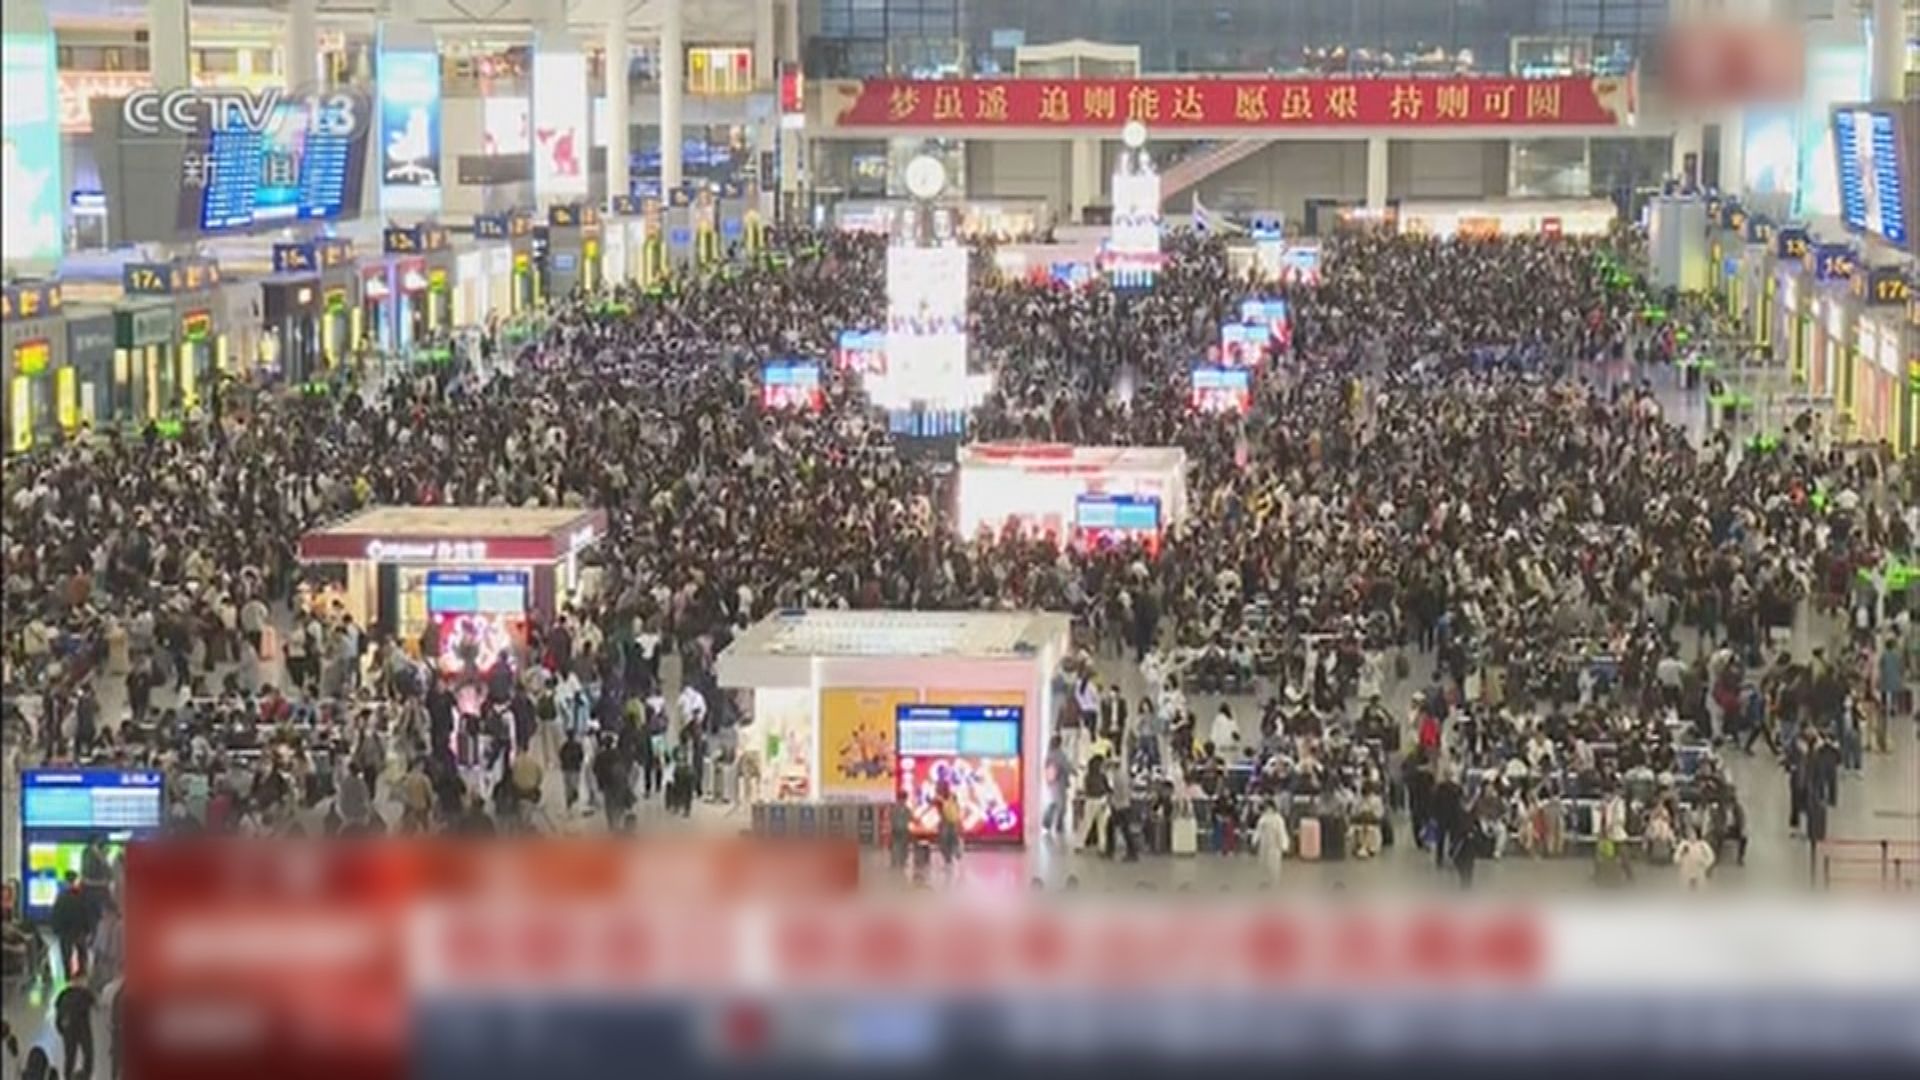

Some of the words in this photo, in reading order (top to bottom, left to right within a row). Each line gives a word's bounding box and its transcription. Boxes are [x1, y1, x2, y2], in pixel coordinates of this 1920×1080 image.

[890, 85, 1008, 121] 梦虽遥
[1038, 85, 1205, 121] 追则能达
[1235, 85, 1358, 121] 愿虽艰
[1390, 83, 1562, 119] 持则可圆
[130, 268, 165, 290] 17A
